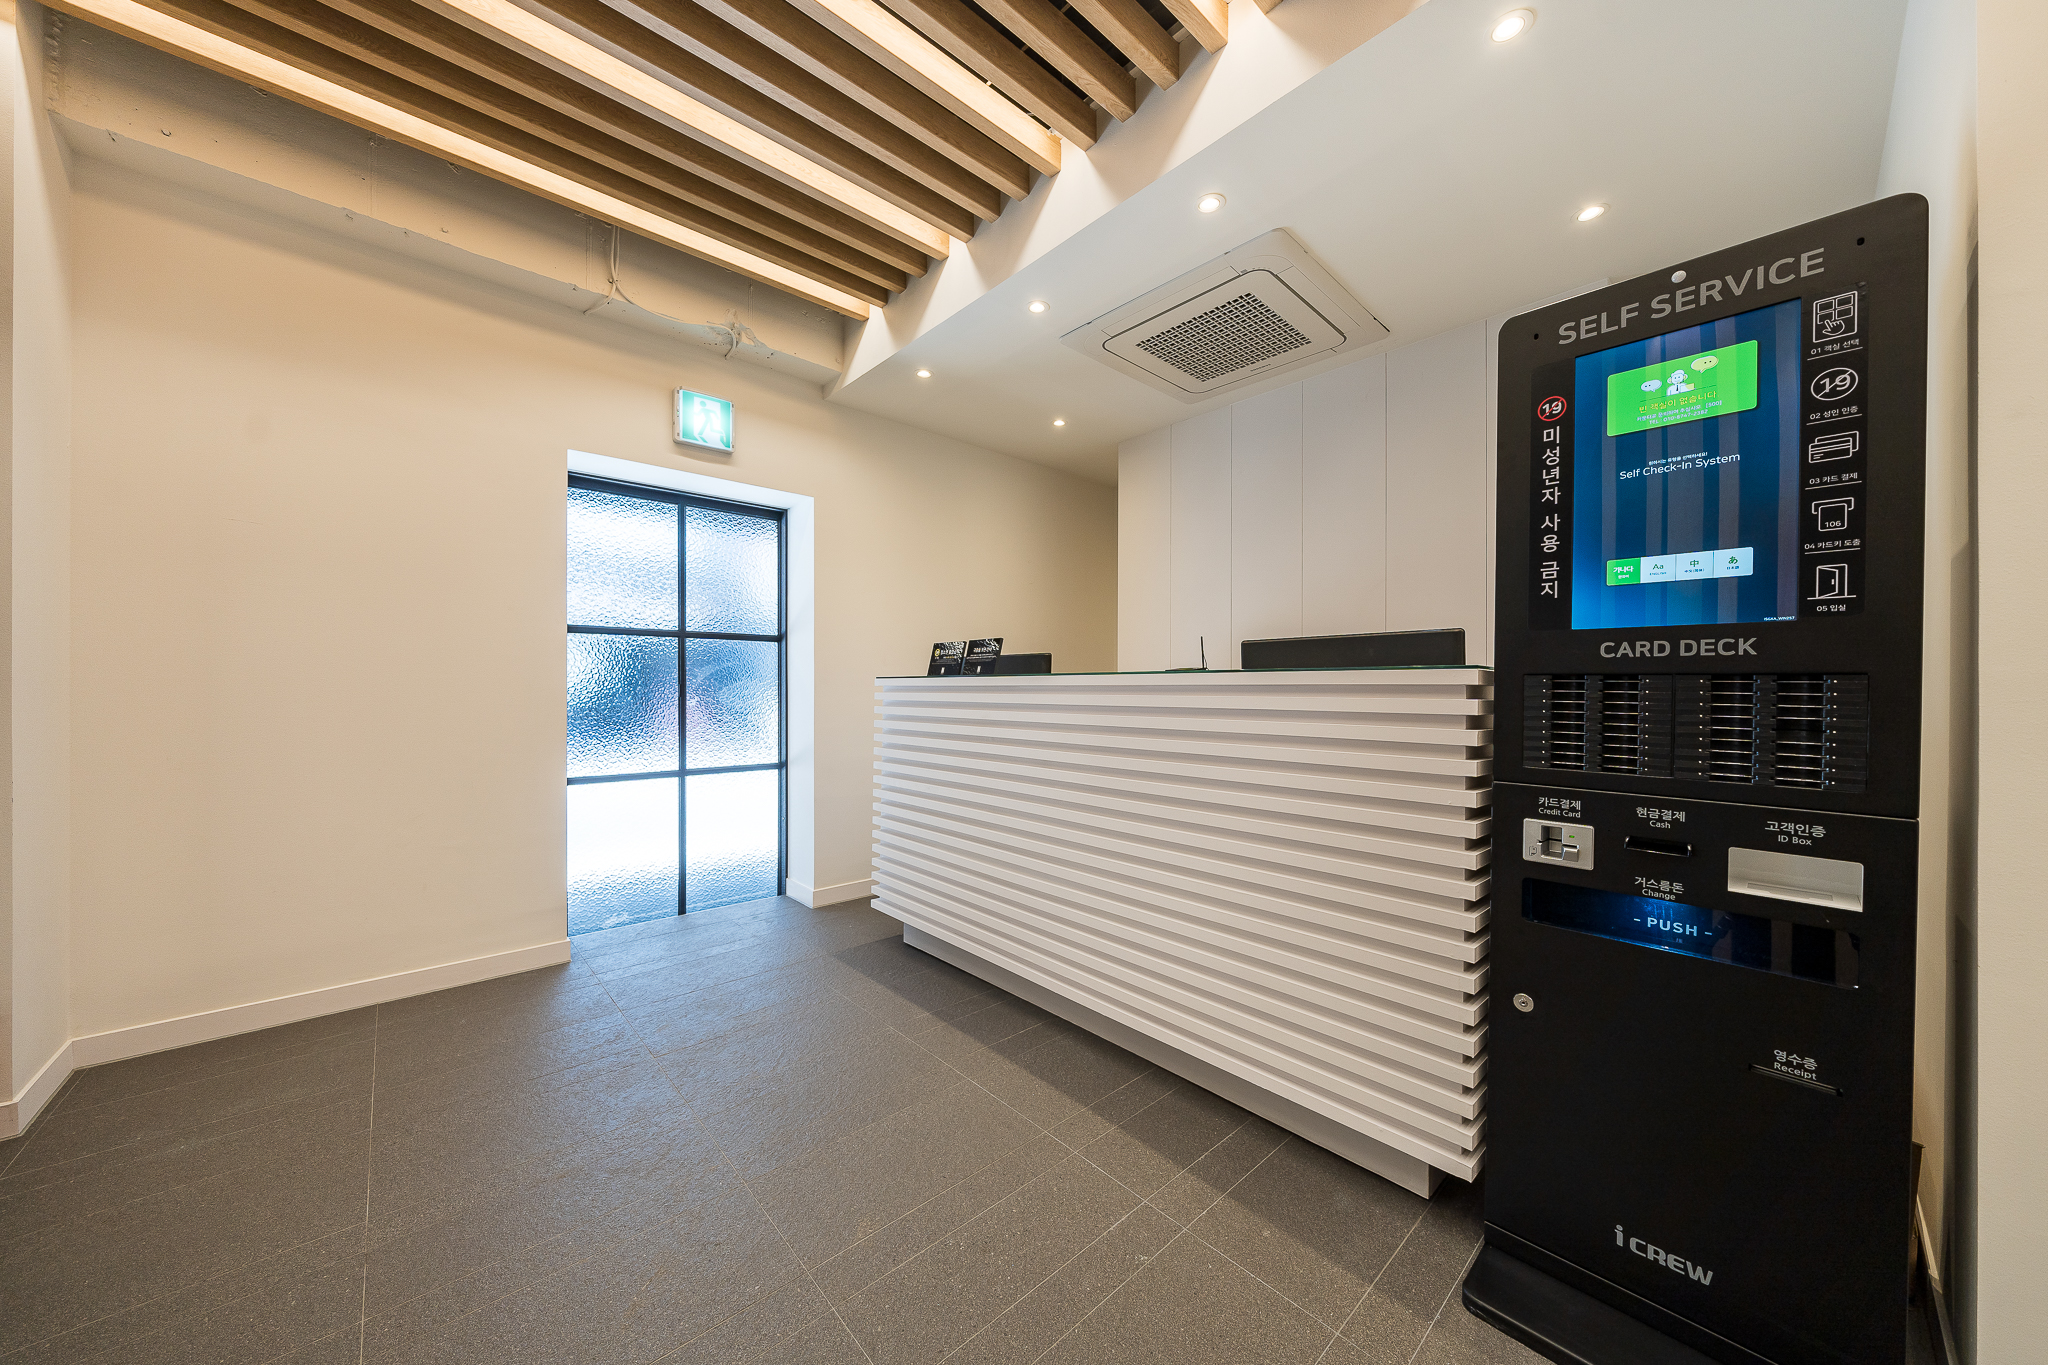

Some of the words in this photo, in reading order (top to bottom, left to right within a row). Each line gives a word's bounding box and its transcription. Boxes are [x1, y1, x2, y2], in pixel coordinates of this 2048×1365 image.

[1558, 302, 1640, 345] SELF
[1650, 247, 1825, 320] SERVICE
[1842, 338, 1860, 348] 선택
[1819, 373, 1851, 393] 19
[1542, 400, 1562, 416] 19
[1638, 404, 1648, 414] 빈
[1810, 412, 1821, 420] 02
[1822, 408, 1840, 418] 성인
[1841, 405, 1859, 415] 인증
[1541, 425, 1562, 505] 미성년자
[1619, 468, 1641, 480] Self
[1642, 460, 1692, 476] Check-In
[1695, 453, 1741, 468] System
[1809, 477, 1821, 485] 03
[1822, 474, 1839, 484] 카드
[1841, 472, 1858, 481] 결제
[1824, 520, 1842, 528] 106
[1540, 513, 1561, 553] 사용
[1804, 542, 1816, 550] 04
[1817, 540, 1842, 549] 카드키
[1689, 559, 1700, 568] 中
[1728, 556, 1738, 565] あ
[1612, 565, 1634, 574] 가나다
[1540, 561, 1560, 599] 금지
[1830, 604, 1846, 612] 입실
[1600, 640, 1671, 658] CARD
[1679, 637, 1758, 657] DECK
[1538, 796, 1582, 811] 카드결제
[1538, 807, 1561, 816] Credit
[1562, 810, 1582, 818] Card
[1636, 806, 1686, 823] 현금결제
[1649, 820, 1671, 829] Cash
[1764, 820, 1827, 838] 고객인증
[1777, 834, 1789, 843] ID
[1792, 836, 1812, 846] Box
[1634, 876, 1685, 894] 거스름돈
[1641, 888, 1676, 901] Change
[1774, 1049, 1818, 1071] 영수증
[1774, 1062, 1817, 1080] Receipt
[1629, 1236, 1714, 1286] CREW
